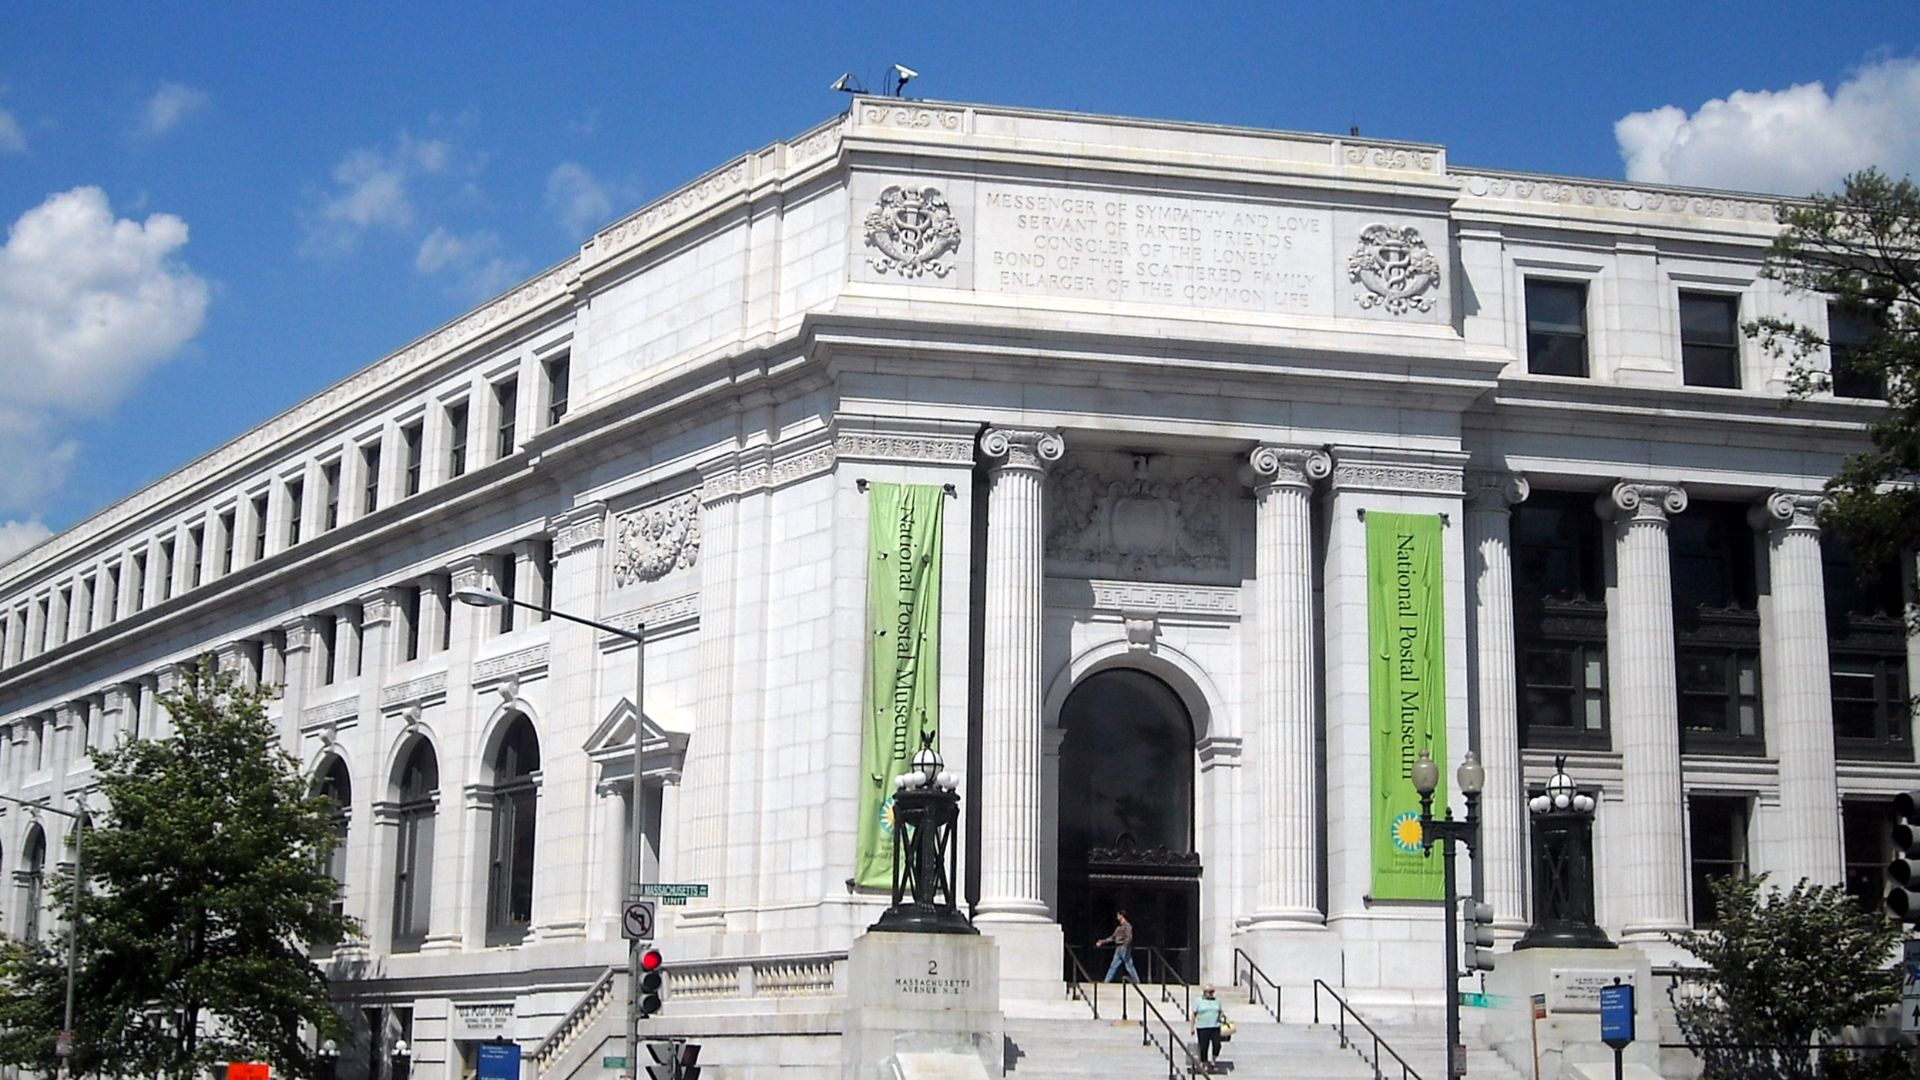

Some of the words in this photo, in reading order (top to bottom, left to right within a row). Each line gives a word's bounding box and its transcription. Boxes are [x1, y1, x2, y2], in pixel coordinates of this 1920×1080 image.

[986, 192, 1097, 215] MESSENGER
[1105, 202, 1127, 217] OF
[1136, 205, 1226, 223] SYMPATHY
[1233, 212, 1269, 229] AND
[1277, 216, 1320, 232] LOVE
[1017, 214, 1098, 232] SERVANT
[1105, 220, 1127, 236] OF
[1136, 223, 1202, 241] PARTED
[1213, 230, 1293, 249] FRIENDS
[994, 250, 1045, 267] BOND
[1057, 255, 1080, 271] OF
[1089, 258, 1124, 274] THE
[1136, 261, 1242, 282] SCATTERED
[1253, 270, 1315, 288] FAMILY
[1034, 235, 1131, 256] CONSOLER
[1139, 243, 1162, 258] OF
[1168, 245, 1202, 261] THE
[1213, 249, 1277, 266] LONELY
[1000, 270, 1097, 292] ENLARGER
[1107, 278, 1130, 294] OF
[1138, 280, 1173, 297] THE
[1183, 285, 1264, 304] COMMON
[1274, 291, 1309, 307] LIFE
[899, 506, 918, 592] National
[1397, 534, 1418, 617] National
[896, 602, 914, 661] Postal
[1399, 626, 1419, 682] Postal
[893, 670, 913, 761] Museum
[1401, 690, 1419, 779] Museum
[644, 885, 698, 896] MASSACHUSETTS
[664, 897, 685, 905] UNIT
[895, 978, 970, 987] MASSACHUSETTS
[928, 960, 938, 975] 2
[489, 1006, 513, 1016] OFFICE
